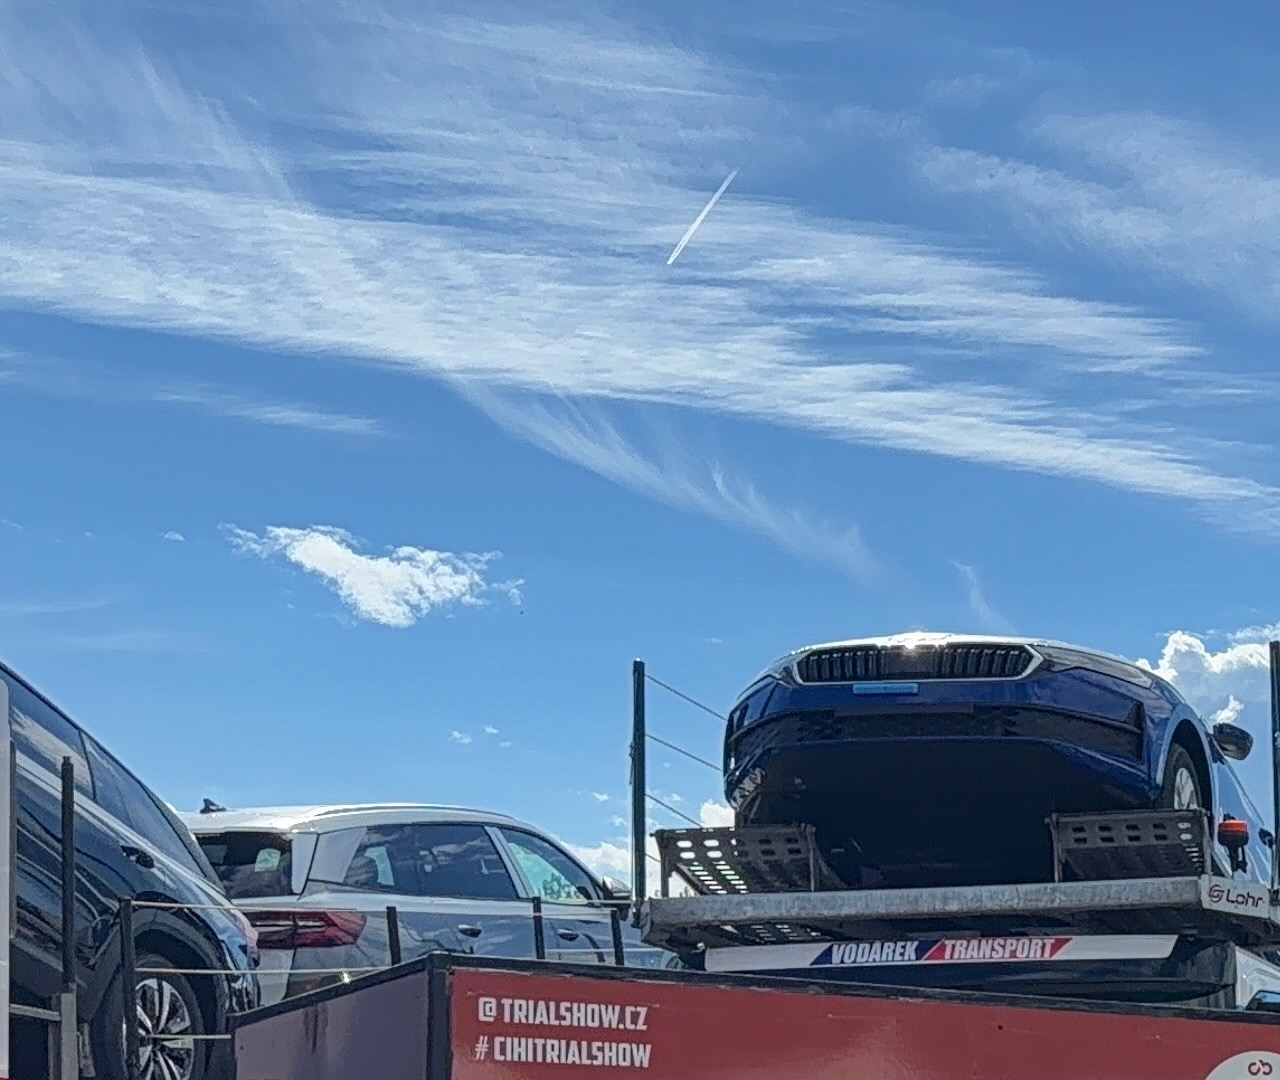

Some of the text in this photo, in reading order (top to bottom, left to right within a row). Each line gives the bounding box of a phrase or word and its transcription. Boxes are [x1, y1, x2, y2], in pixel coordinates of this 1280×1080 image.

[1226, 889, 1263, 908] Lohr
[943, 938, 1056, 959] TRANSPORT
[478, 997, 648, 1030] @ TRIALSHOW.CZ
[475, 1035, 652, 1068] # CIHITRIALSHOW
